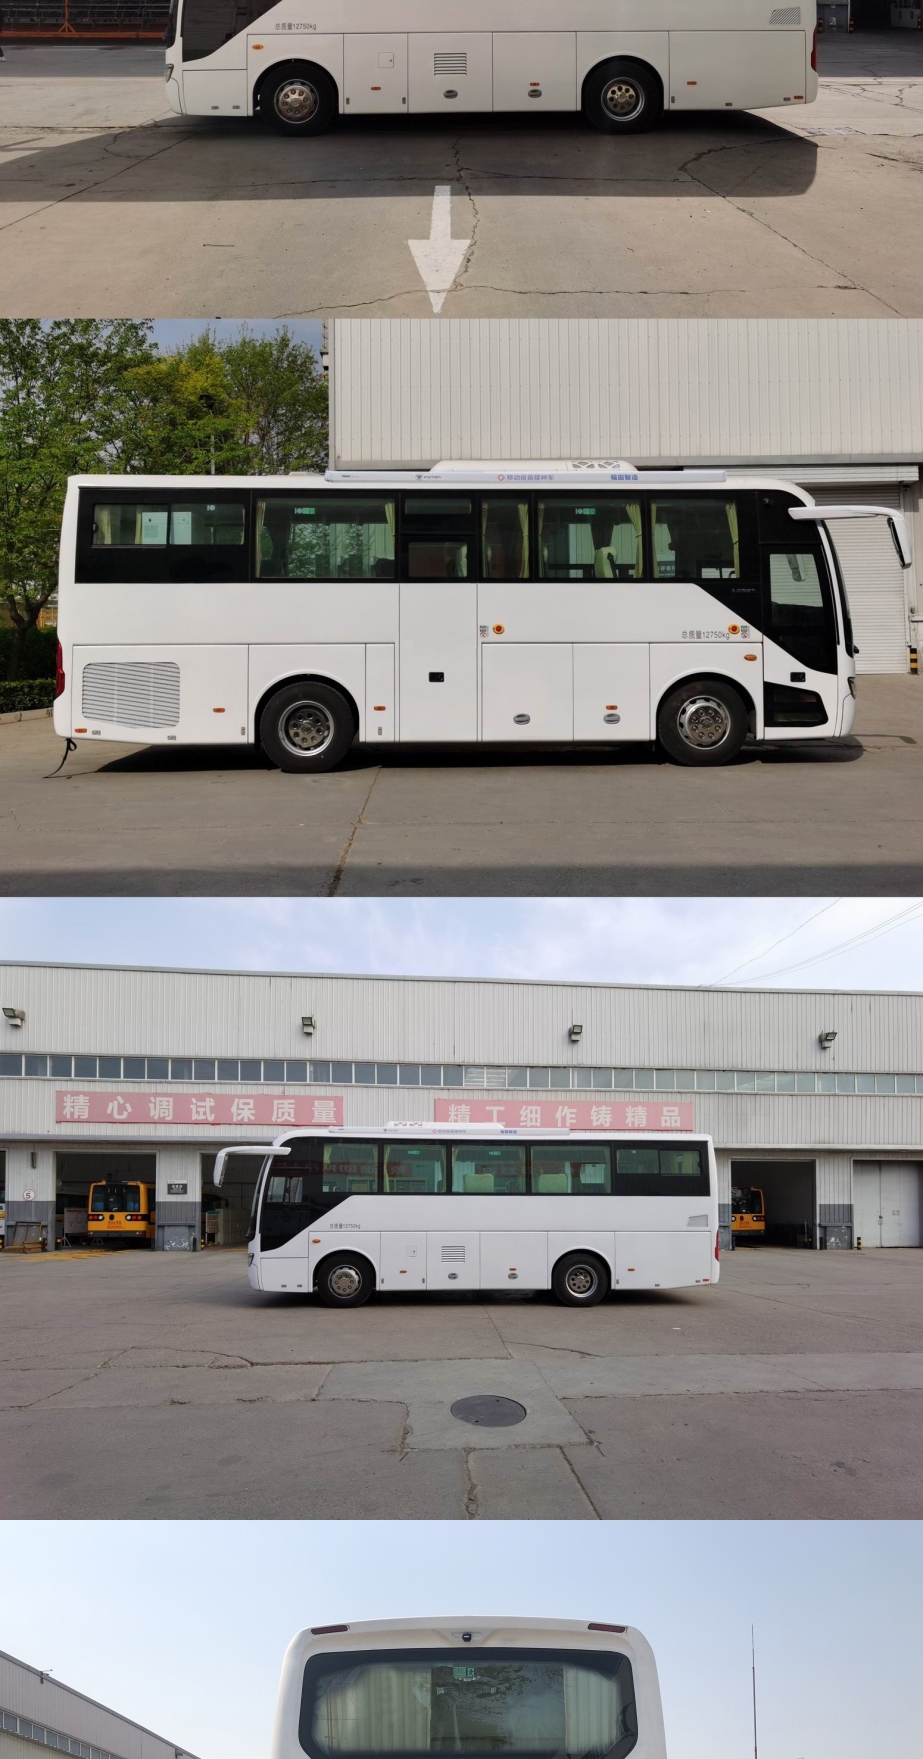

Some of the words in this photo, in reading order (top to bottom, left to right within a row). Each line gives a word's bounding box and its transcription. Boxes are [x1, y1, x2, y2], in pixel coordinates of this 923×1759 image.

[681, 630, 730, 640] 总质量12750kg
[63, 1094, 337, 1124] 精心调试保质量
[448, 1103, 681, 1128] 精工细作铸精品
